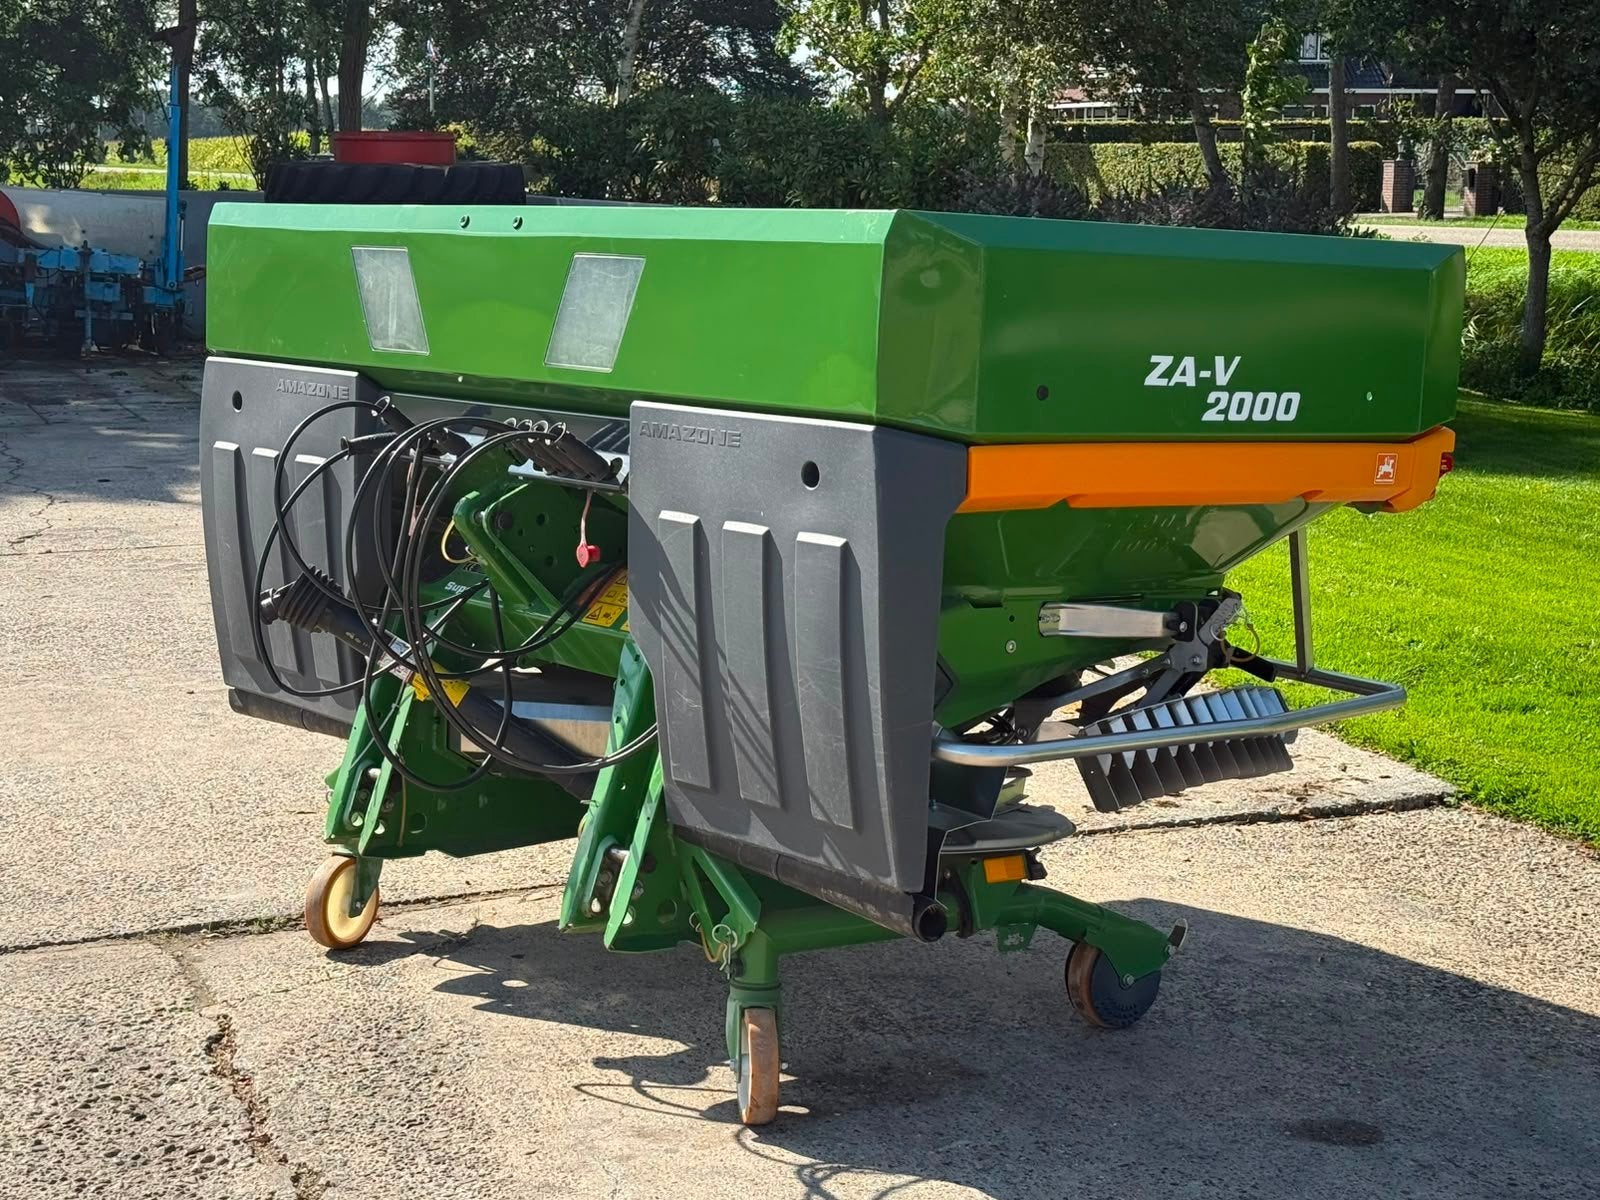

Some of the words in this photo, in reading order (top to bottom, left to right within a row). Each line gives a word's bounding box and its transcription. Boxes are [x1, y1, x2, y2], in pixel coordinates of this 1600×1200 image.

[1143, 355, 1242, 387] ZA-V
[276, 379, 350, 400] AMAZONE
[1201, 391, 1301, 421] 2000
[639, 420, 741, 448] AMAZONE
